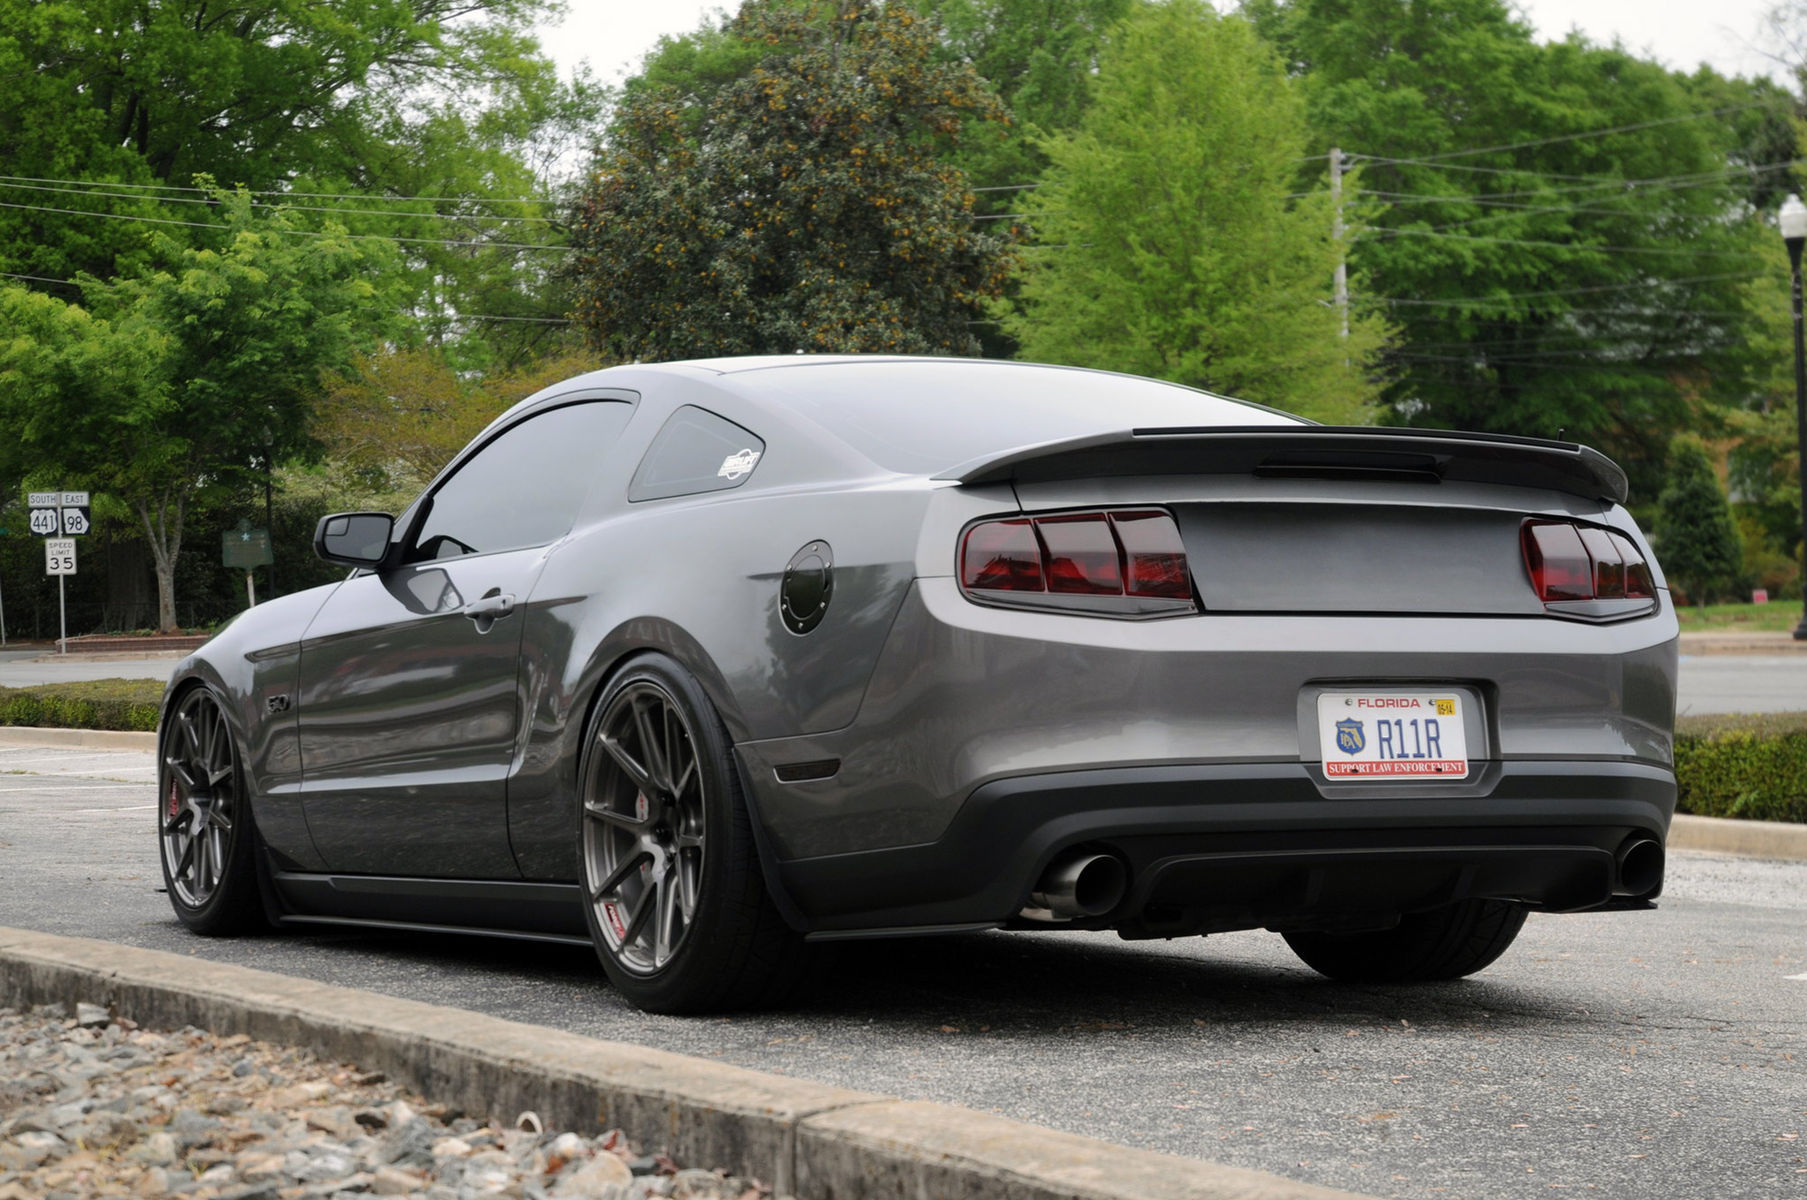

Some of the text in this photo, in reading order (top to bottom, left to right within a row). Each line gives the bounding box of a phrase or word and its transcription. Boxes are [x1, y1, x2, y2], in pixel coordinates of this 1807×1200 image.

[30, 494, 56, 504] SOUTH
[65, 494, 84, 503] EAST
[33, 515, 54, 530] 441
[67, 516, 82, 531] 98
[50, 557, 74, 570] 35
[1358, 698, 1420, 708] FLORIDA
[1377, 718, 1442, 759] R11R
[1329, 762, 1463, 773] SUPPORT LAW ENFORCEMENT
